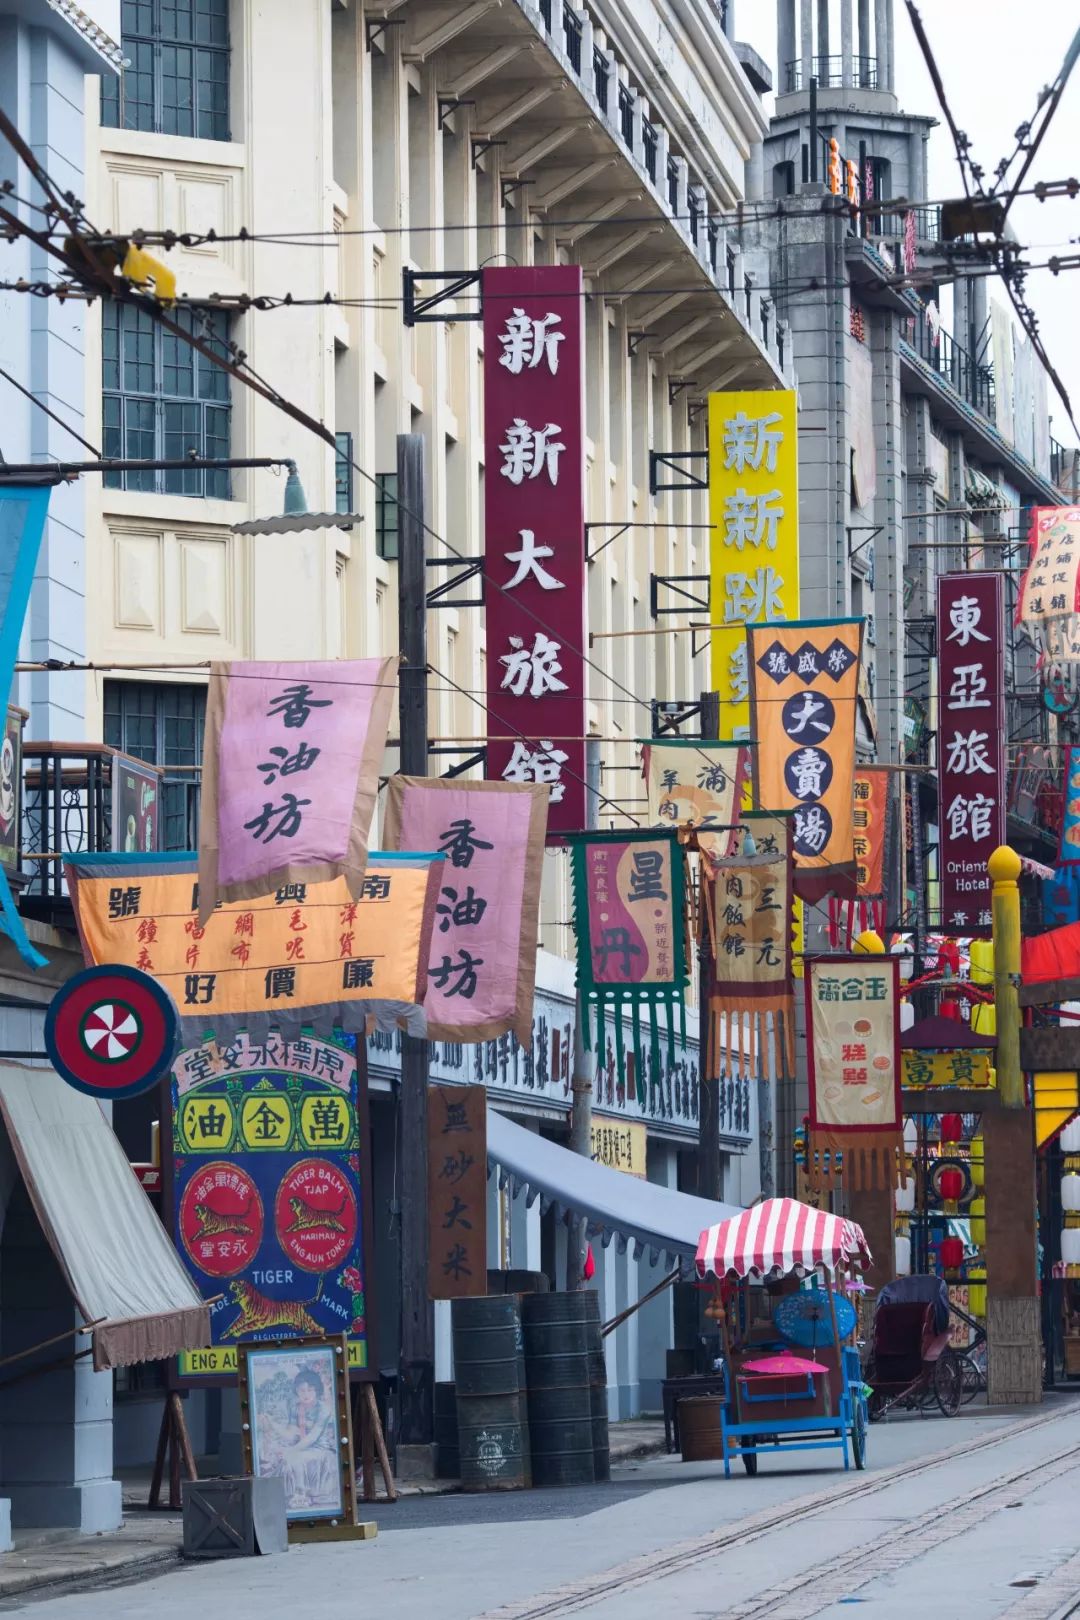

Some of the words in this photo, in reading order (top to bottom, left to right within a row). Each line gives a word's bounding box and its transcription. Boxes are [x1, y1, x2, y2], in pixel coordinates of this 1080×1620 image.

[497, 307, 570, 804] 新新大旅館
[722, 411, 785, 760] 新新跳
[945, 595, 996, 842] 東亞旅館
[244, 684, 333, 844] 香油坊
[787, 692, 831, 851] 大賣場
[658, 769, 681, 828] 羊肉
[628, 850, 668, 902] 星
[947, 860, 988, 873] Orient
[956, 877, 989, 891] Hotel
[427, 819, 494, 999] 香油坊
[722, 873, 746, 959] 肉飯館
[289, 1168, 316, 1192] TIGER
[318, 1168, 345, 1194] BALM
[304, 1185, 329, 1195] TJAP
[290, 1239, 306, 1258] ENG
[305, 1252, 325, 1264] AUN
[325, 1238, 346, 1261] TONG
[300, 1232, 336, 1241] HARIMAU
[252, 1270, 294, 1285] TIGER
[211, 1295, 229, 1316] ADE
[321, 1294, 349, 1320] MARK
[191, 1353, 218, 1370] ENG
[222, 1351, 238, 1368] AU
